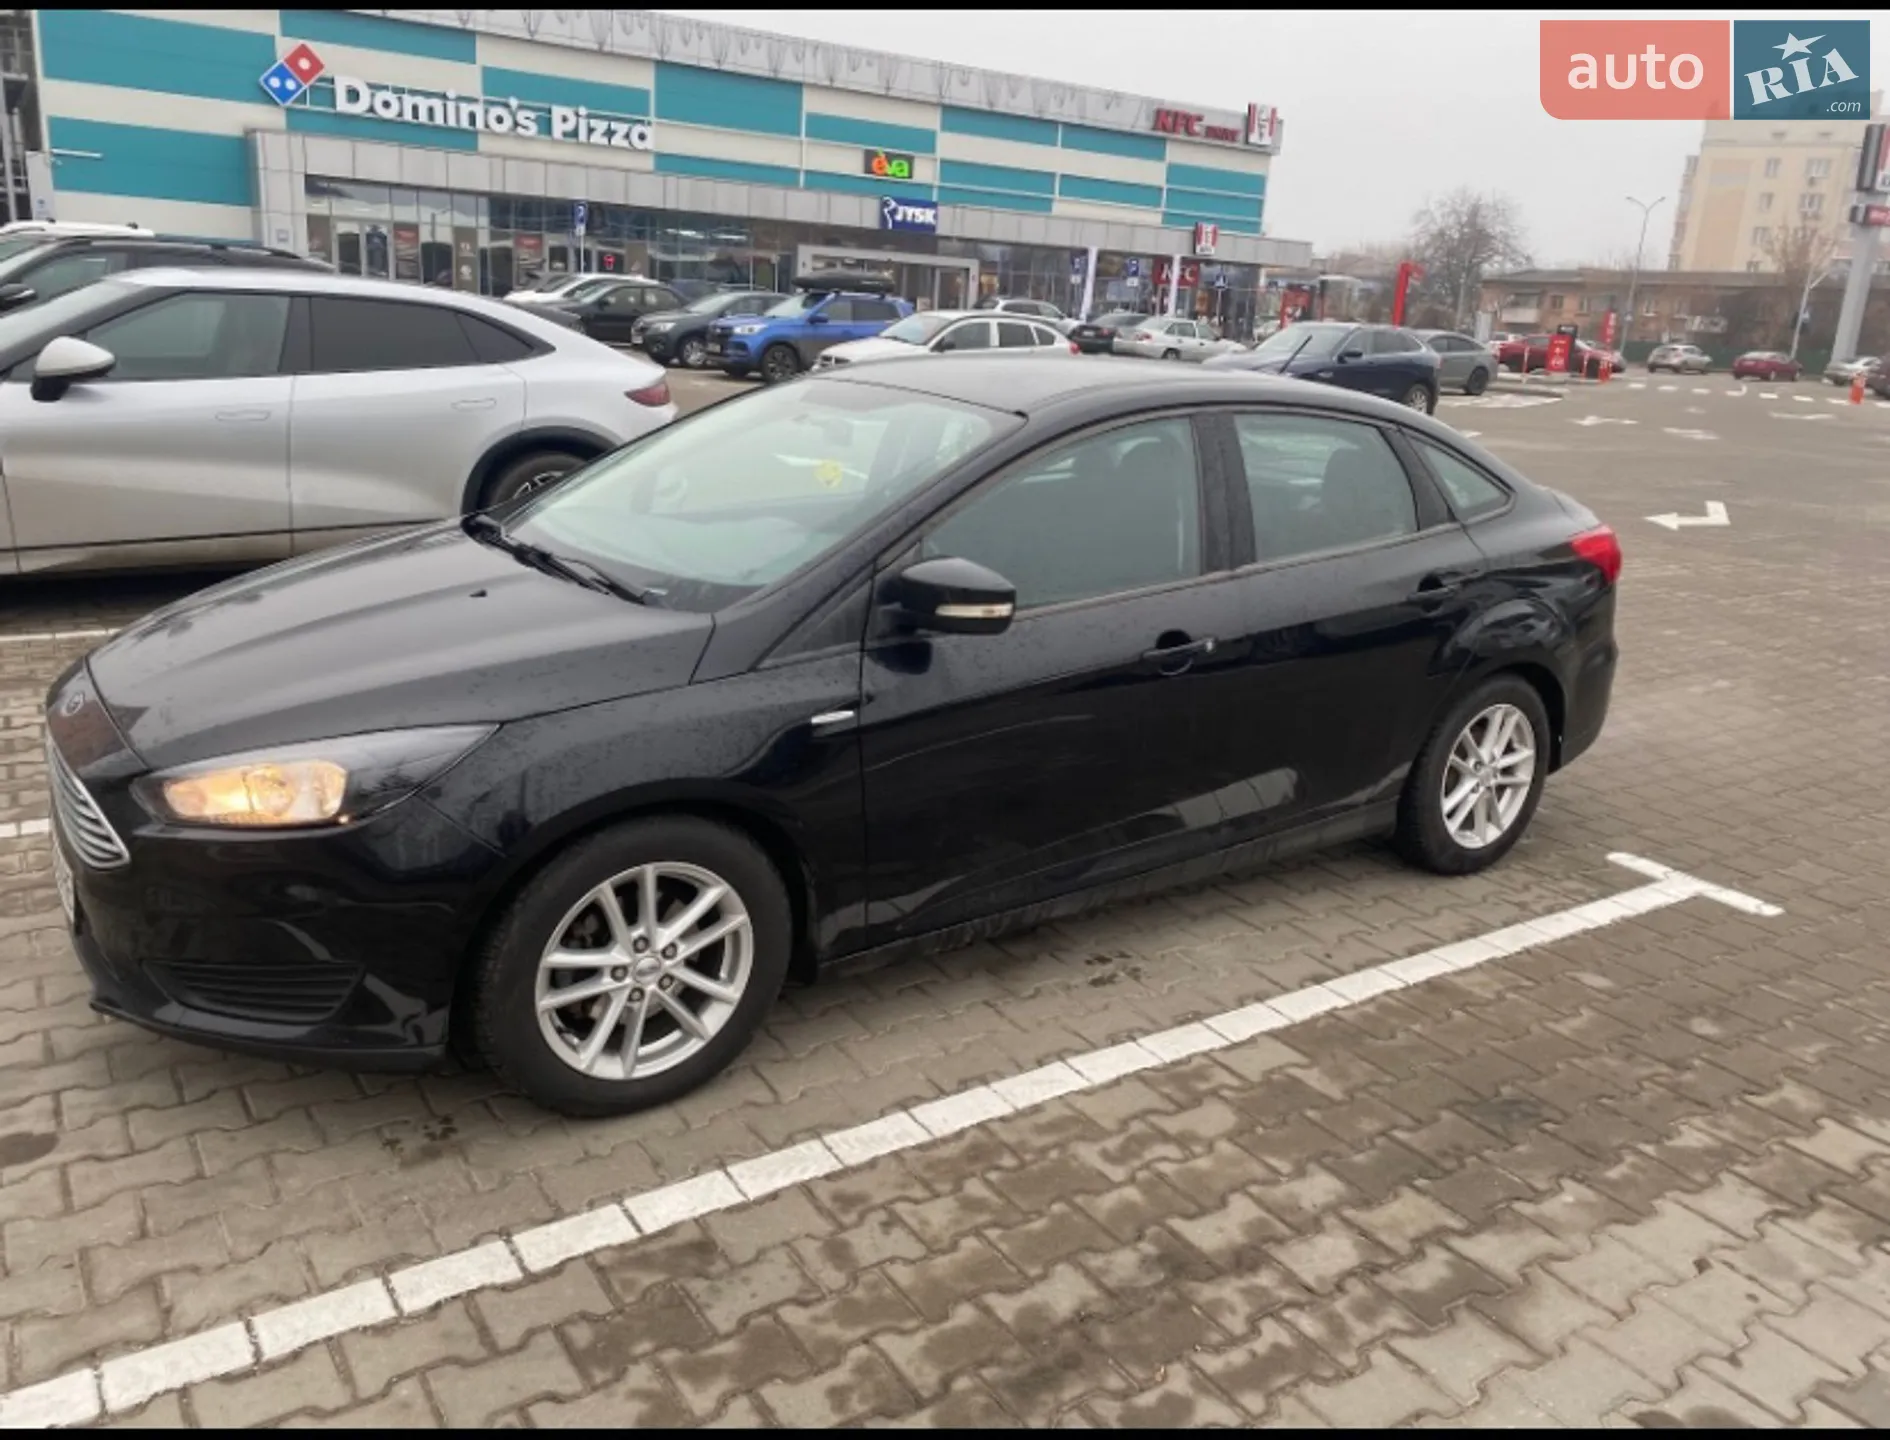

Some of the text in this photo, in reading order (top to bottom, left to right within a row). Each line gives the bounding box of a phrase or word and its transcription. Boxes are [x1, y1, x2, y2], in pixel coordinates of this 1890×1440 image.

[333, 75, 654, 150] Domino's Pizza
[1154, 108, 1205, 137] KFC
